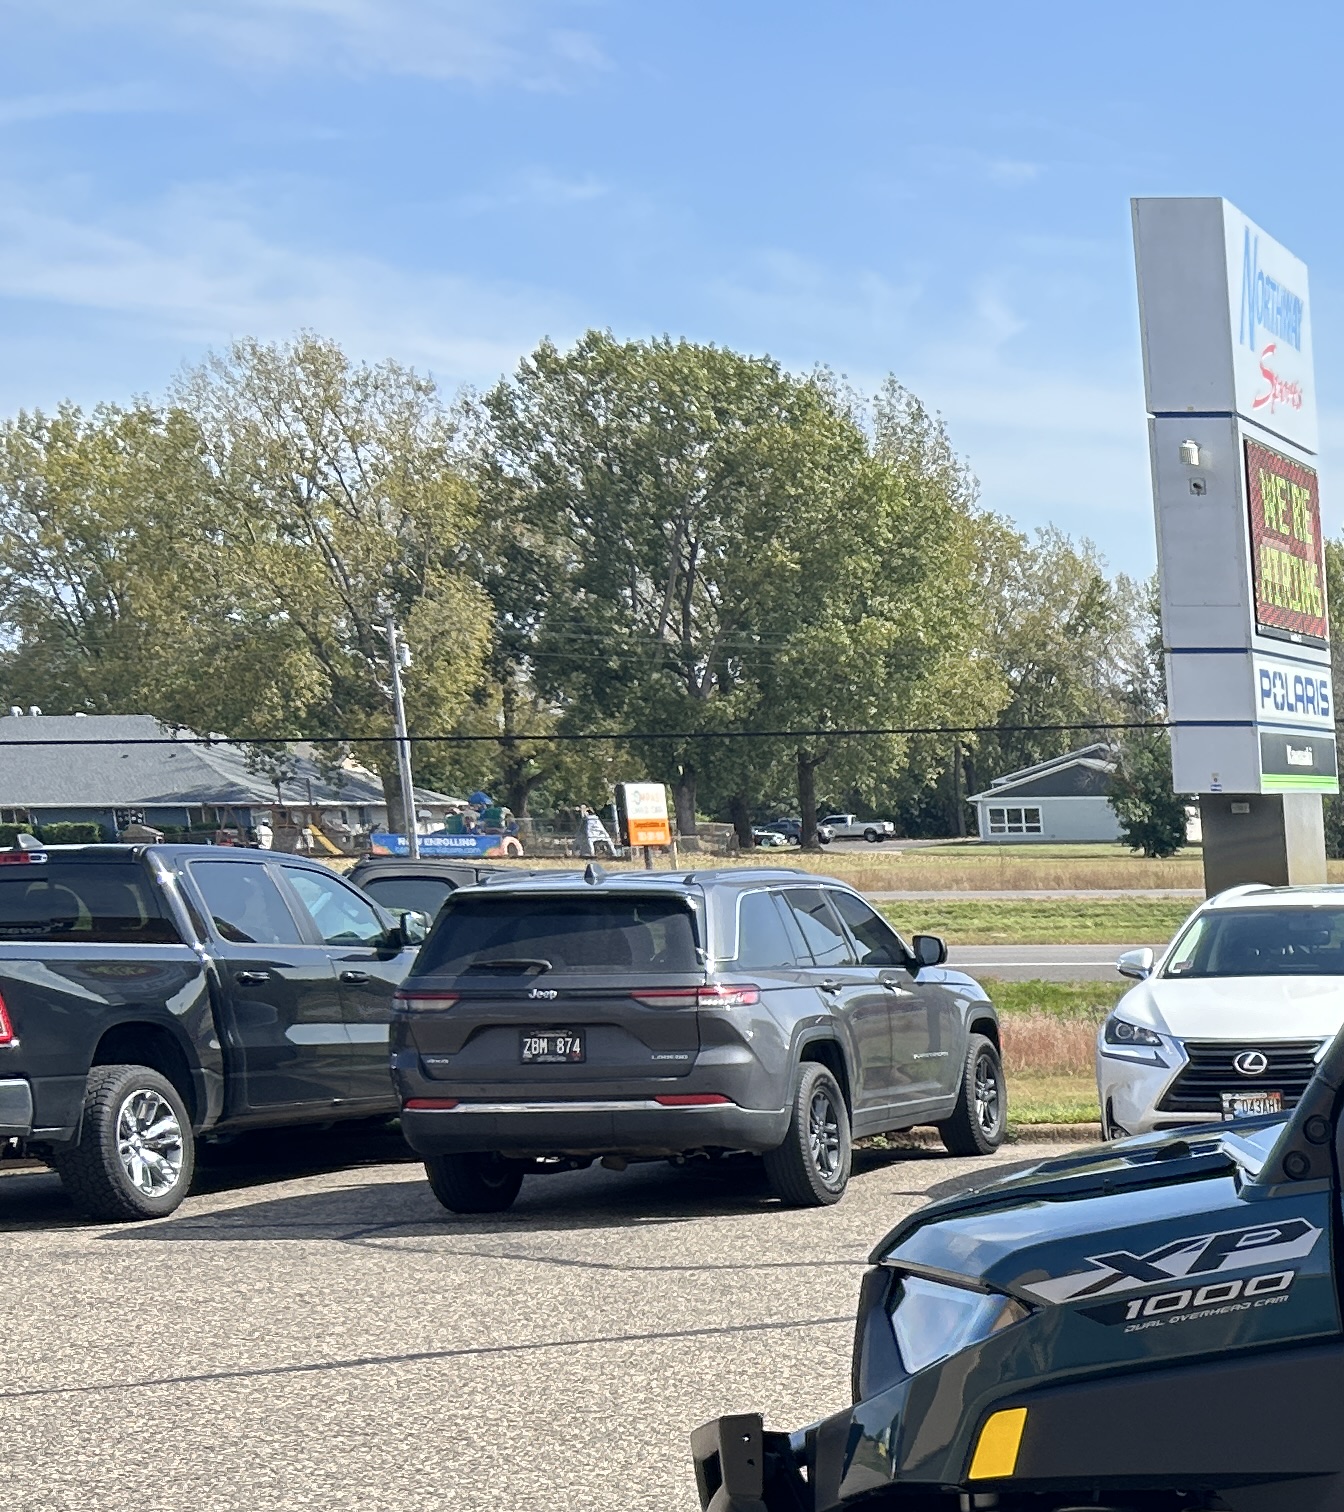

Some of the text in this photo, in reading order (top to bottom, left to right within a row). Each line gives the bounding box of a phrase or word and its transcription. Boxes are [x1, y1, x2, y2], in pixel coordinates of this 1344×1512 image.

[1259, 668, 1330, 717] POLARIS
[528, 988, 558, 1000] Jeep
[523, 1037, 581, 1055] ZBM 874
[1065, 1219, 1314, 1300] XP
[1124, 1294, 1290, 1333] DUAL OVERHEAD CAM
[1125, 1270, 1296, 1320] 1000
